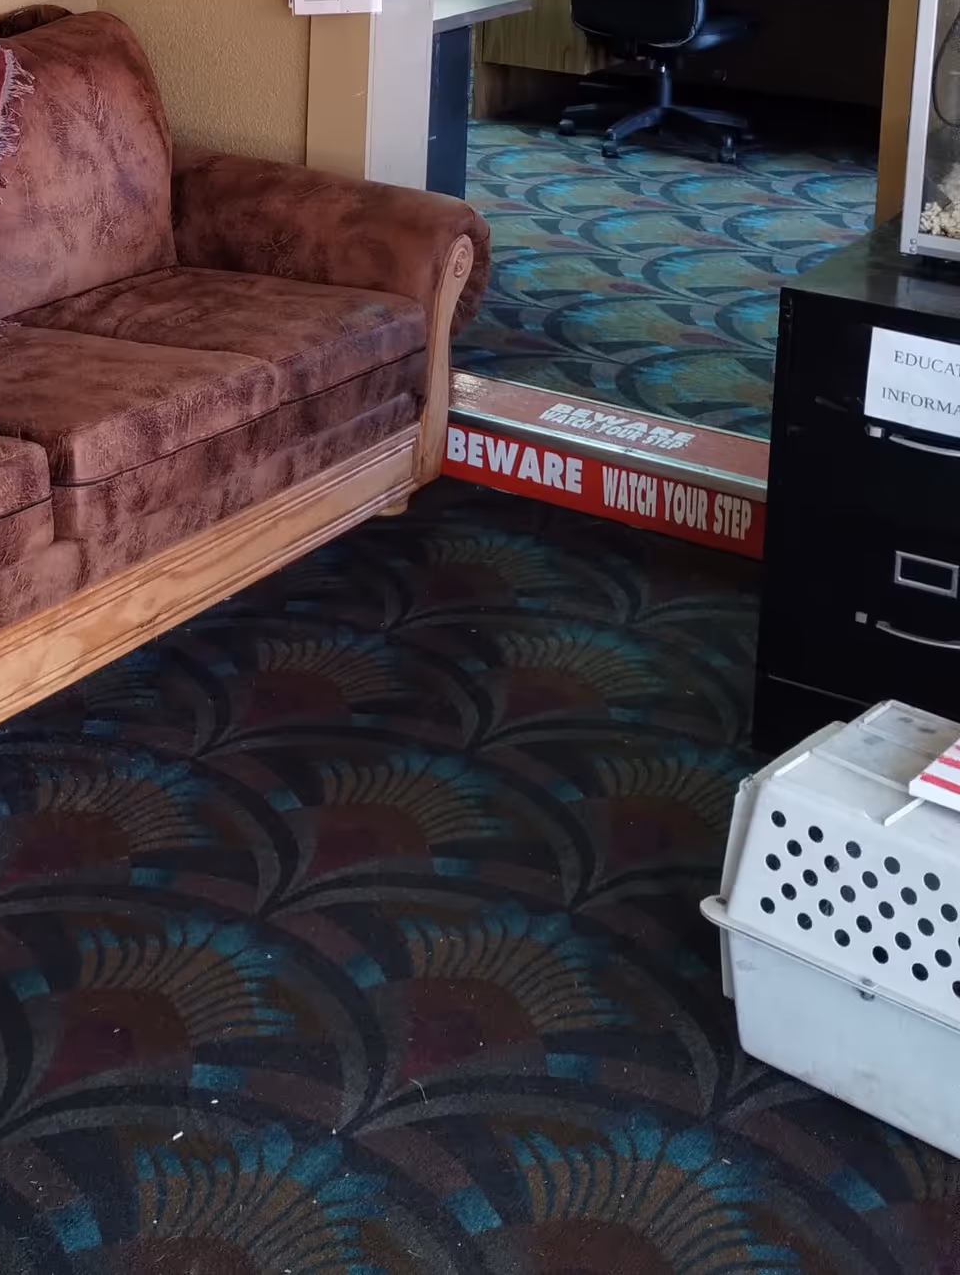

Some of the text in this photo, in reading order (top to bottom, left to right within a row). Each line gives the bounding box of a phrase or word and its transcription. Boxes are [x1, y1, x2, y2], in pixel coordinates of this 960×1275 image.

[539, 403, 696, 443] BEWARE
[446, 426, 583, 494] BEWARE
[602, 465, 752, 540] WATCH YOUR STEP
